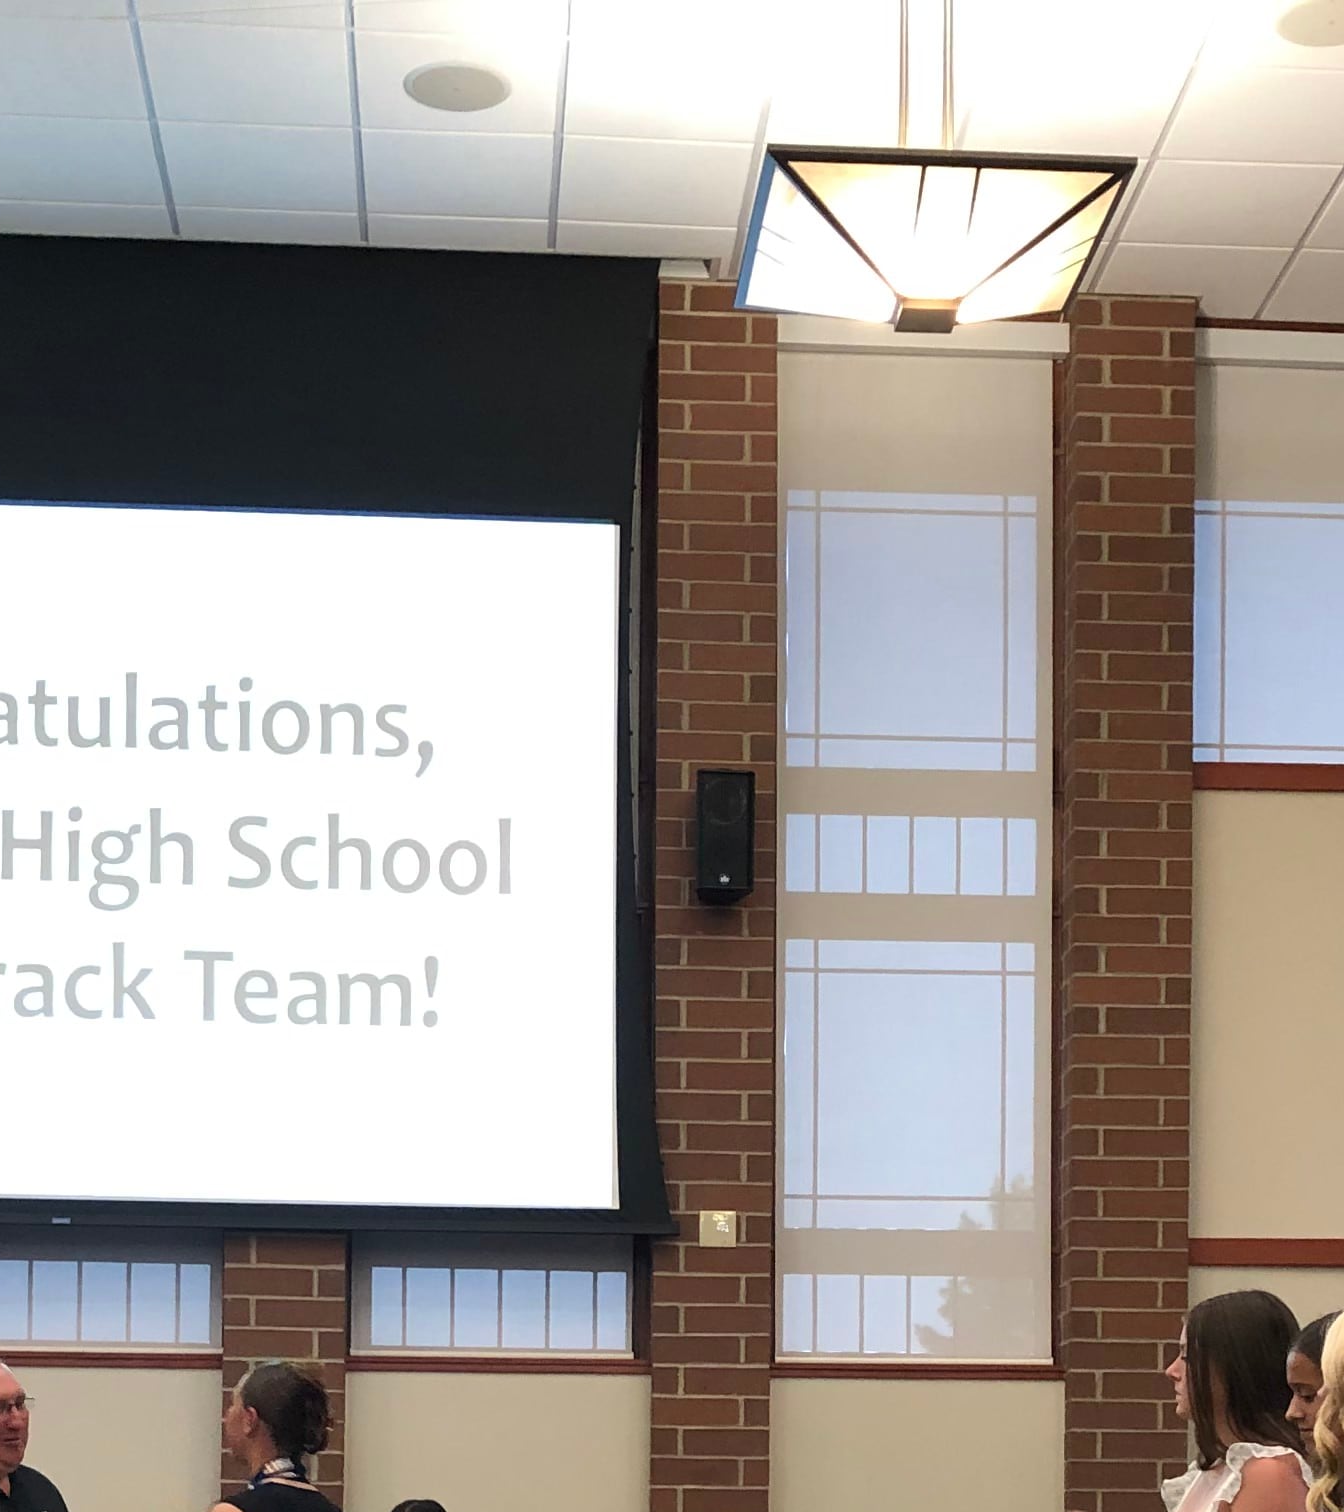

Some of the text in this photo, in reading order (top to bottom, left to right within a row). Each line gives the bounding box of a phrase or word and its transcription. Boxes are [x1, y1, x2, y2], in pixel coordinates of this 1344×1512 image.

[0, 805, 194, 912] High
[226, 813, 513, 896] School
[184, 949, 441, 1029] Team!
